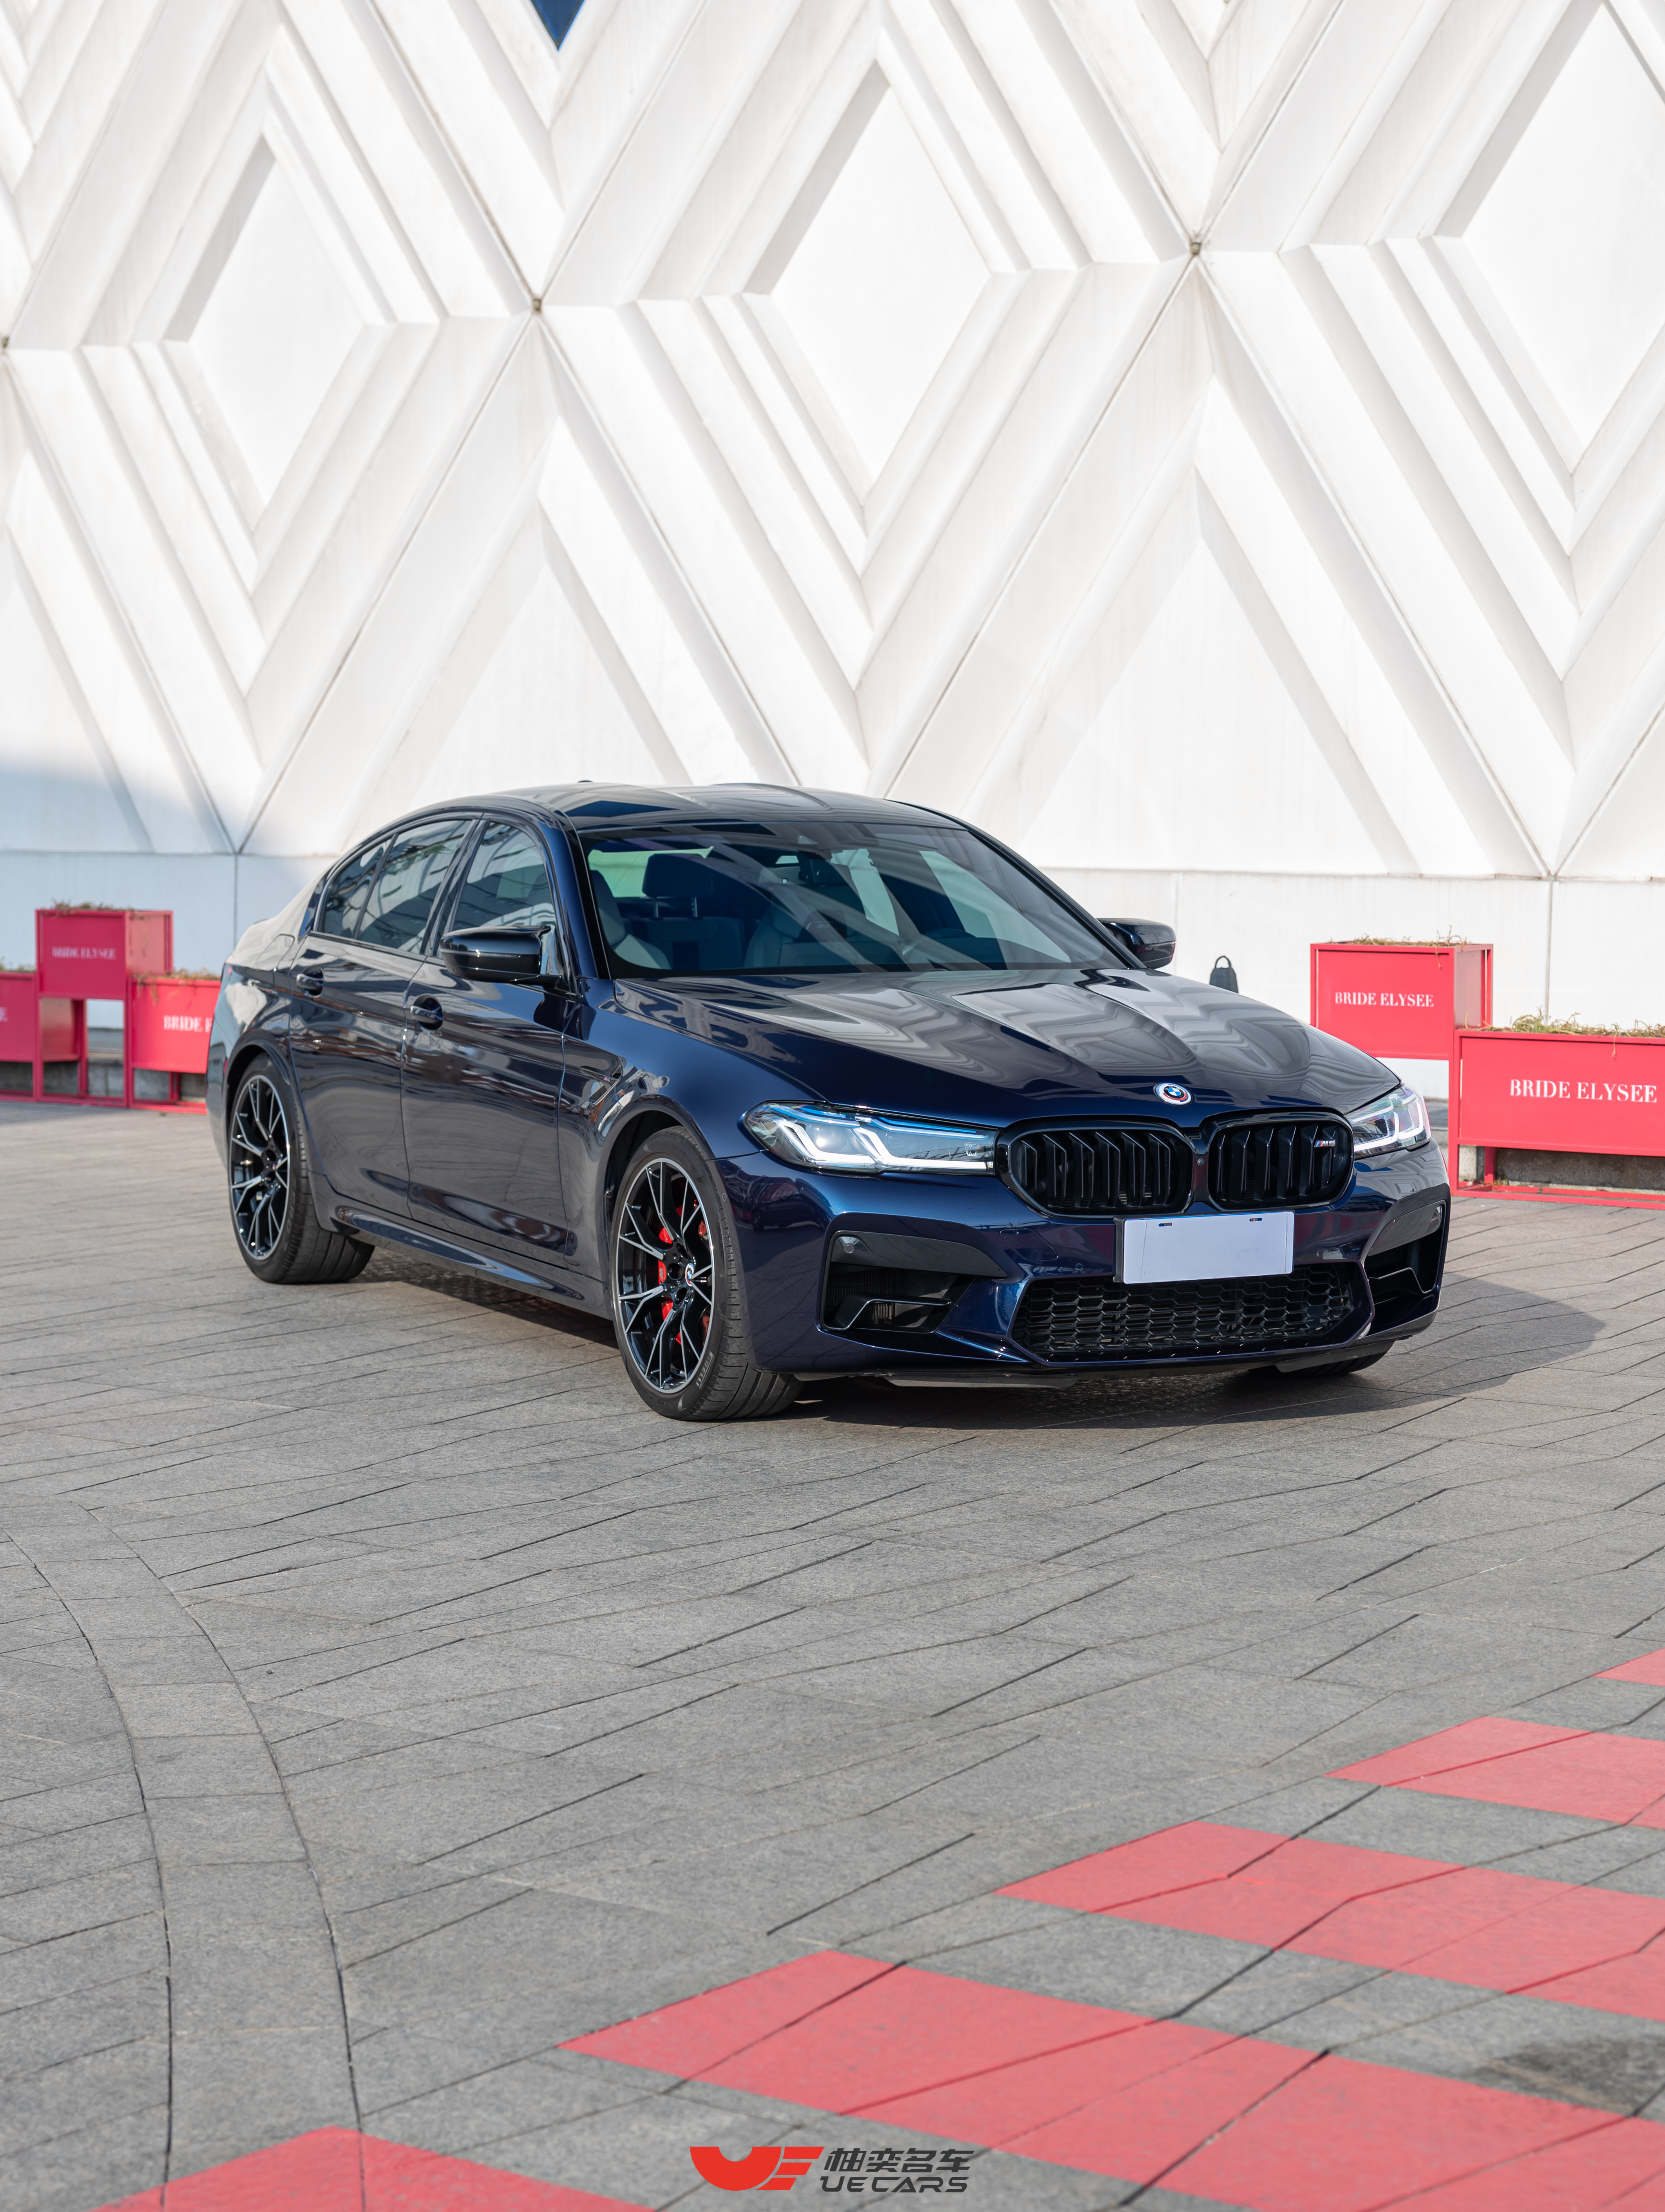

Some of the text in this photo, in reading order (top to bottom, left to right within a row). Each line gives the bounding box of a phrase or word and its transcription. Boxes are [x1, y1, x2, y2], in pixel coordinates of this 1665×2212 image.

[1335, 992, 1434, 1007] BRIDE ELYSEE
[164, 1015, 203, 1032] BRIDE
[1511, 1079, 1657, 1103] BRIDE ELYSEE
